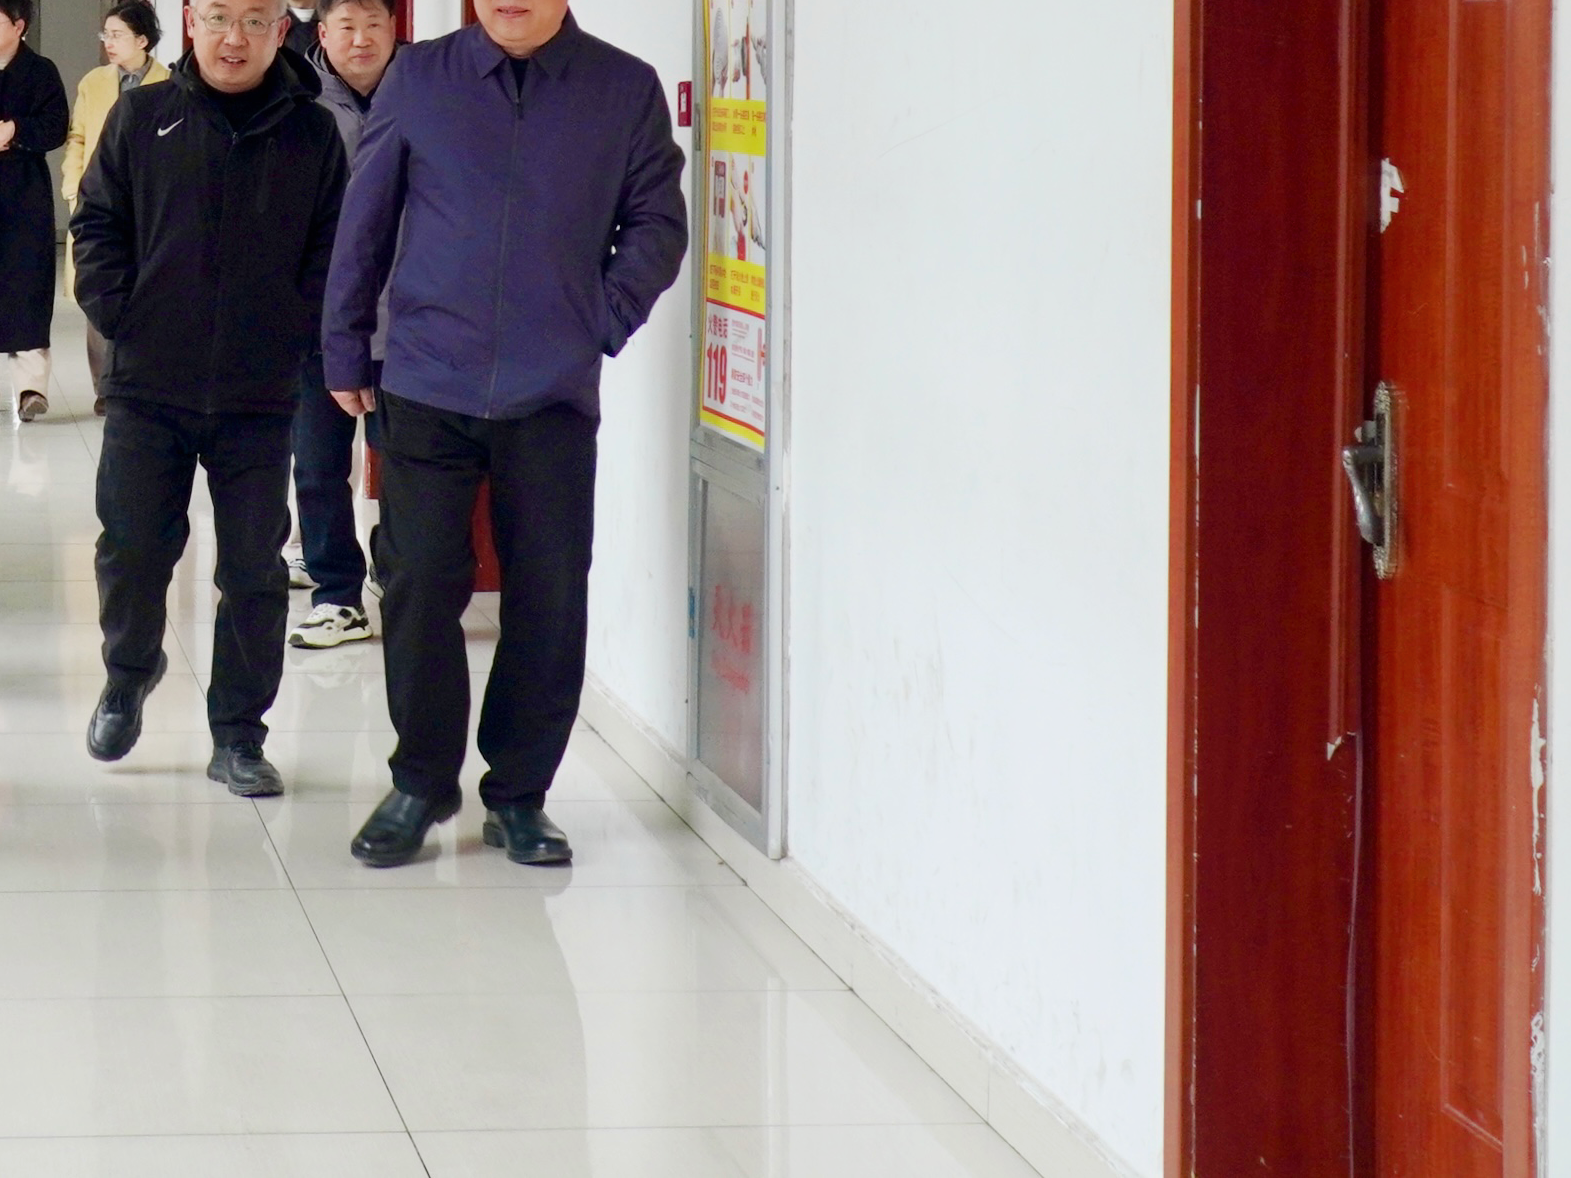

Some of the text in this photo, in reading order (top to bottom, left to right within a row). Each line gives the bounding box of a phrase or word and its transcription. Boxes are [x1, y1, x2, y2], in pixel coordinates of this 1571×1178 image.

[707, 313, 728, 340] 火警电话
[706, 341, 728, 405] 119
